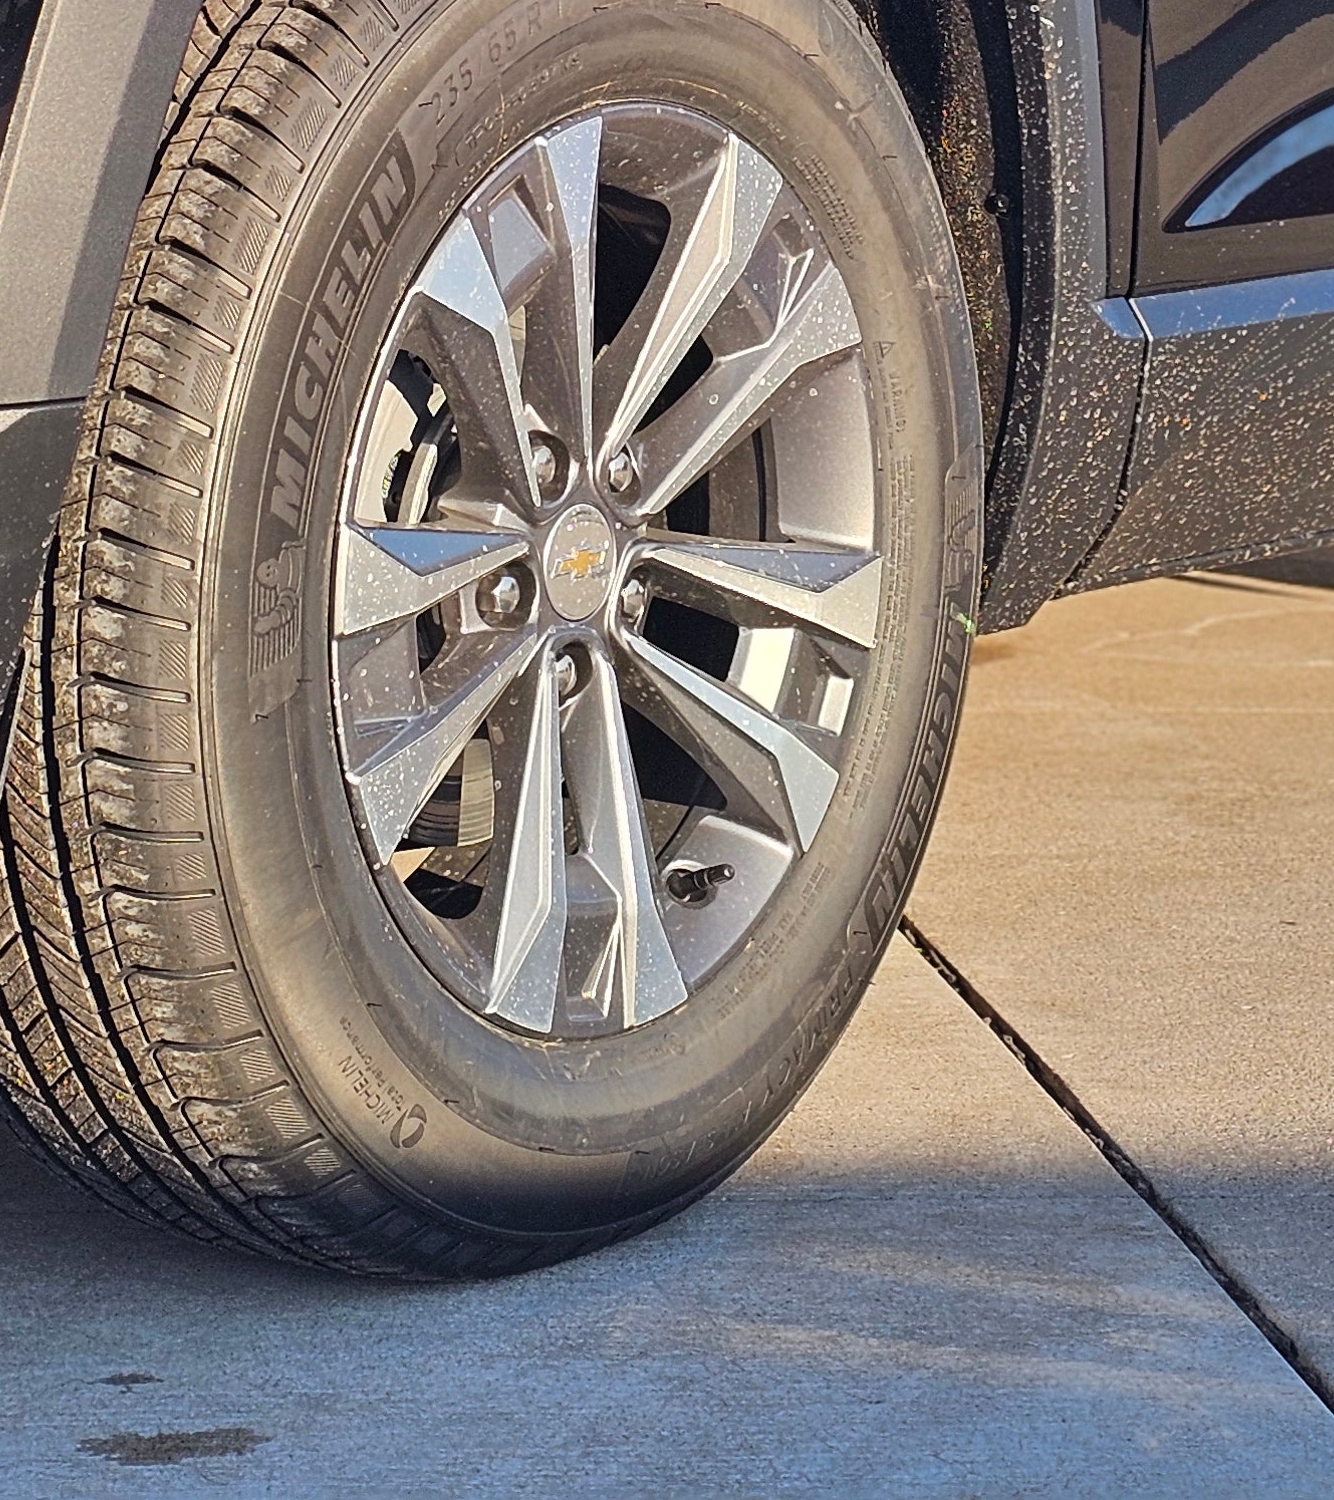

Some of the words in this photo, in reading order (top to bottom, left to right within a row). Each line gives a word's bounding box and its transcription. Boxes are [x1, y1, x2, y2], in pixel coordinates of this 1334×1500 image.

[270, 154, 408, 531] MICHELIN
[870, 599, 971, 931] MICHELIN
[338, 1055, 395, 1125] MICHELIN
